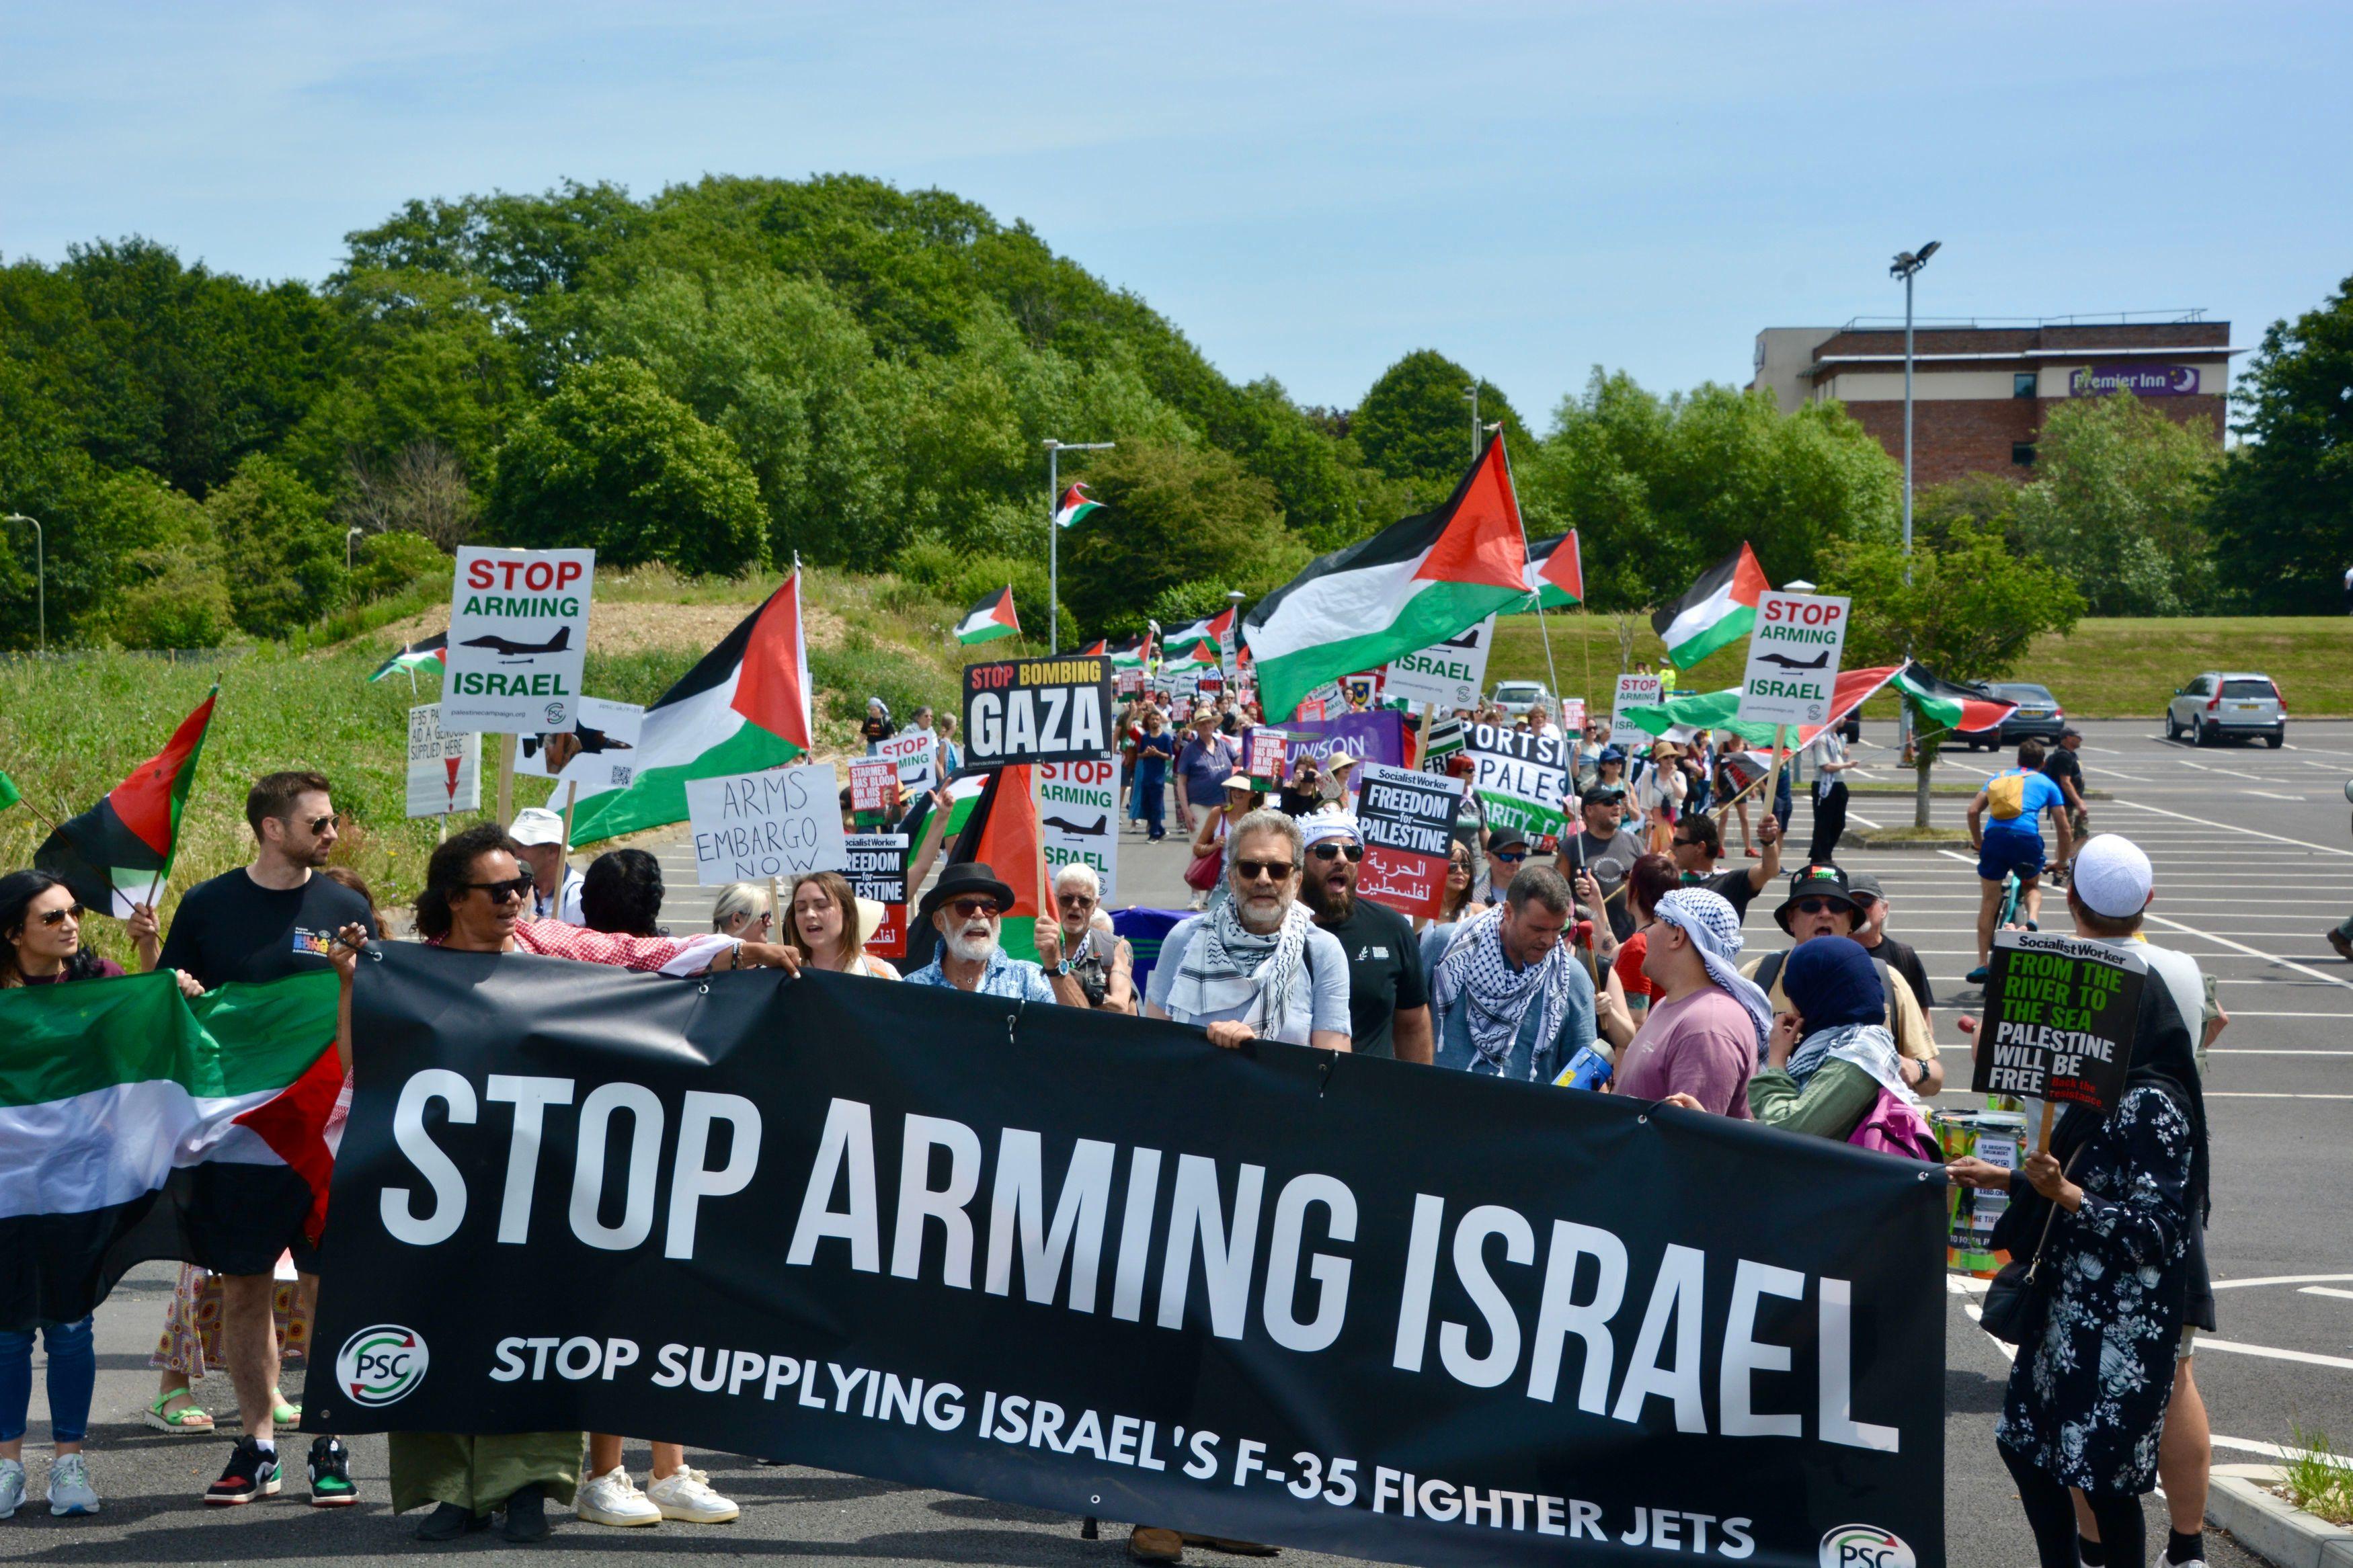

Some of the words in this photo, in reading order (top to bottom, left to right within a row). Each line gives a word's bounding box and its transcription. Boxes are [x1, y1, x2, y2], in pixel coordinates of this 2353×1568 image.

[2074, 373, 2137, 389] Premier
[2140, 373, 2165, 388] Inn
[467, 559, 582, 591] STOP
[463, 595, 580, 618] ARMING
[1765, 600, 1841, 626] STOP
[1759, 625, 1837, 645] ARMING
[972, 665, 1014, 690] STOP
[1019, 660, 1101, 686] BOMBING
[1395, 654, 1474, 682] ISRAEL
[453, 672, 569, 696] ISRAEL
[1621, 679, 1657, 692] STOP
[1749, 679, 1825, 700] ISRAEL
[1326, 700, 1343, 712] RAEL
[1619, 692, 1656, 700] ARMING
[411, 710, 427, 726] F-35
[430, 708, 442, 725] PA
[451, 709, 526, 718] palestinecampaign.org
[548, 710, 563, 718] PSC
[971, 686, 1105, 757] GAZA
[411, 727, 423, 743] AID
[426, 726, 432, 741] A
[1254, 737, 1280, 749] STARMER
[411, 742, 441, 760] SUPPLIED
[882, 737, 928, 757] STOP
[1267, 747, 1285, 758] BLOOD
[1285, 735, 1365, 764] UNISON
[851, 765, 887, 778] STARMER
[898, 753, 929, 770] MING
[1252, 765, 1272, 776] HANDS
[1253, 755, 1261, 766] ON
[852, 777, 868, 788] HAS
[869, 775, 895, 787] BLOOD
[1041, 760, 1113, 785] STOP
[1379, 769, 1417, 785] Socialist
[1417, 777, 1448, 790] Worker
[723, 771, 807, 819] ARMS
[853, 788, 865, 798] ON
[867, 787, 880, 797] HIS
[854, 797, 881, 809] HANDS
[1041, 784, 1111, 808] ARMING
[1368, 784, 1450, 819] FREEDOM
[1399, 812, 1414, 824] for
[696, 817, 817, 862] EMBARGO
[845, 838, 871, 847] ocialist
[871, 838, 897, 846] Worker
[1359, 817, 1449, 854] PALESTINE
[735, 847, 820, 879] NOW
[844, 852, 900, 872] REEDOM
[1043, 845, 1109, 873] SRAEL
[1368, 852, 1425, 877] الحرية
[861, 872, 873, 881] for
[1356, 877, 1430, 901] لفلسطين
[2019, 936, 2077, 956] Socialist
[2077, 944, 2126, 965] Worker
[2008, 952, 2073, 983] FROM
[2082, 962, 2124, 993] THE
[2005, 976, 2070, 1006] RIVER
[2079, 985, 2107, 1011] TO
[2001, 999, 2044, 1023] THE
[2050, 1006, 2091, 1032] SEA
[1996, 1022, 2115, 1063] PALESTINE
[1993, 1044, 2045, 1071] WILL
[2052, 1054, 2083, 1077] BE
[1989, 1067, 2044, 1094] FREE
[2051, 1077, 2076, 1088] Back
[2079, 1080, 2096, 1093] the
[2048, 1089, 2102, 1108] resistance
[380, 1067, 762, 1260] STOP
[786, 1097, 1357, 1352] ARMING
[1393, 1193, 1900, 1453] ISRAEL
[356, 1354, 410, 1379] PSC
[489, 1335, 639, 1383] STOP
[651, 1343, 965, 1432] SUPPLYING
[979, 1391, 1219, 1480] ISRAEL'S
[1234, 1440, 1357, 1506] F-35
[1373, 1467, 1608, 1544] FIGHTER
[1622, 1505, 1755, 1559] JETS
[1840, 1544, 1895, 1568] PSC
